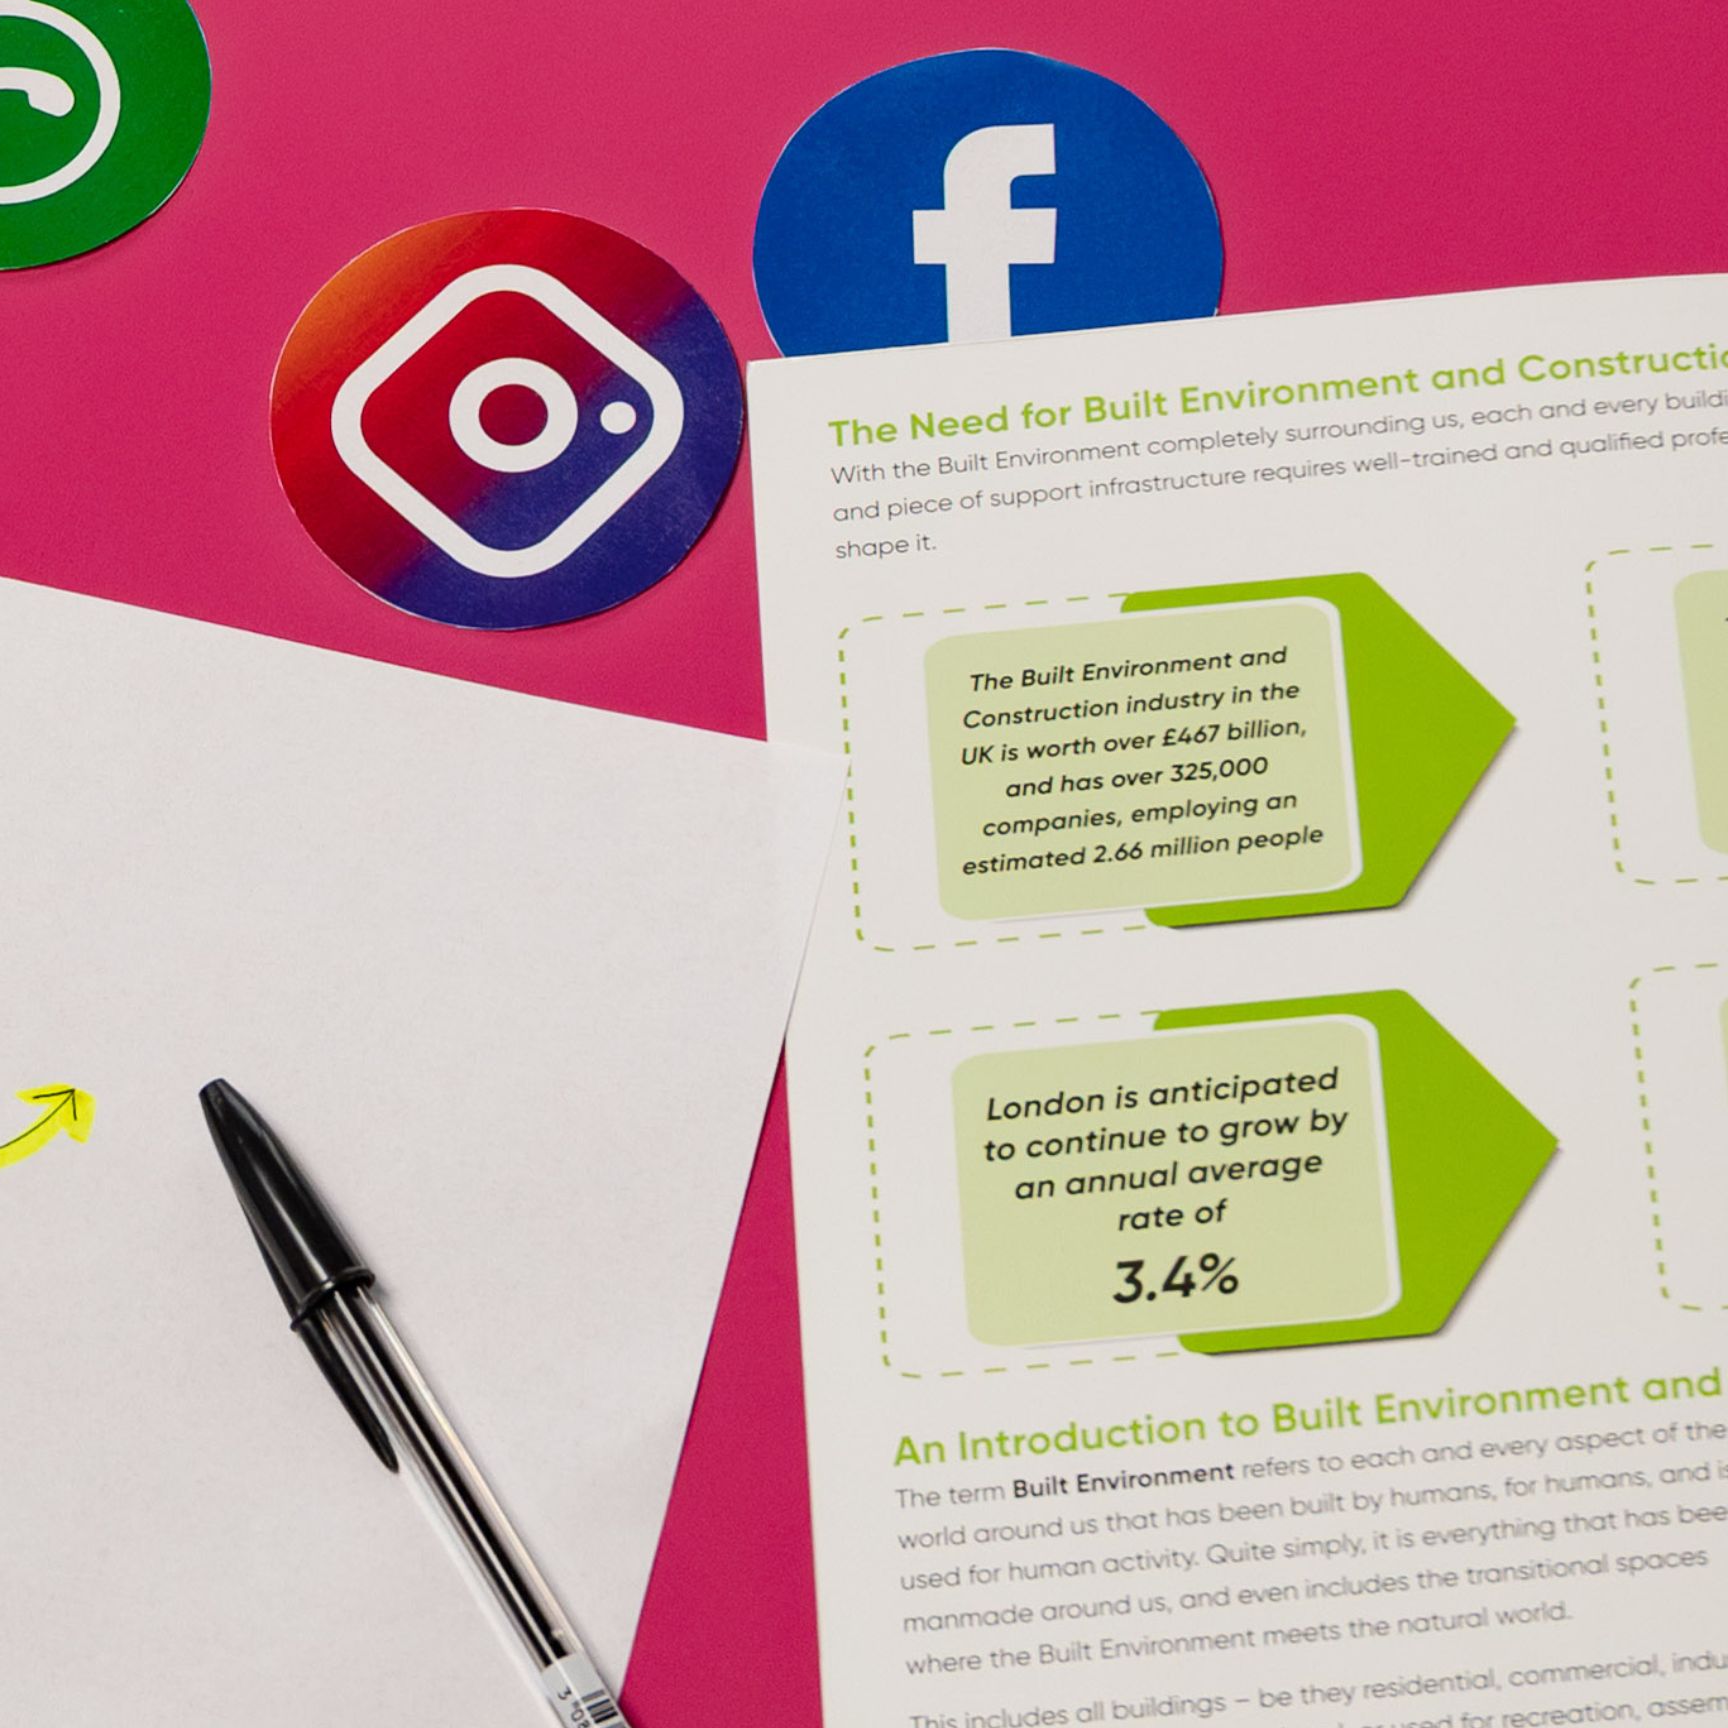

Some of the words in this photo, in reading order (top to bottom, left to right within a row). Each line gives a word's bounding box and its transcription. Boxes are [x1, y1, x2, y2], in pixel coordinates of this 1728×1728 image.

[826, 417, 899, 449] The
[909, 403, 1010, 441] Need
[1019, 400, 1073, 430] for
[1082, 388, 1170, 425] Built
[1178, 367, 1421, 416] Environment
[1429, 356, 1507, 392] and
[828, 462, 887, 486] With
[890, 459, 933, 481] the
[936, 451, 990, 476] Built
[994, 439, 1142, 471] Environment
[1145, 425, 1280, 457] completely
[1283, 413, 1427, 444] surrounding
[1430, 412, 1466, 431] us,
[1469, 402, 1534, 427] each
[1537, 397, 1588, 421] and
[1591, 396, 1660, 418] every
[968, 671, 1015, 693] The
[1020, 663, 1076, 689] Built
[1081, 651, 1234, 683] Environment
[1238, 644, 1289, 669] and
[961, 698, 1120, 730] Construction
[1125, 690, 1226, 715] industry
[1230, 684, 1254, 705] in
[1258, 681, 1301, 703] the
[960, 743, 996, 767] UK
[999, 742, 1020, 763] is
[1025, 735, 1097, 761] worth
[1102, 733, 1157, 754] over
[1160, 722, 1222, 748] £467
[1226, 718, 1307, 742] billion,
[1004, 774, 1055, 799] and
[1059, 773, 1105, 794] has
[1110, 769, 1165, 789] over
[1169, 755, 1270, 784] 325,000
[981, 807, 1124, 838] companies,
[1129, 795, 1260, 826] employing
[1264, 793, 1299, 812] an
[961, 845, 1088, 877] estimated
[1091, 840, 1145, 865] 2.66
[1149, 834, 1231, 860] million
[1235, 824, 1325, 856] people
[985, 1089, 1106, 1122] London
[1114, 1084, 1140, 1111] is
[1147, 1064, 1340, 1108] anticipated
[982, 1139, 1017, 1164] to
[1025, 1126, 1168, 1160] continue
[1176, 1121, 1210, 1145] to
[1218, 1115, 1301, 1148] grow
[1309, 1107, 1350, 1138] by
[1013, 1178, 1056, 1201] an
[1064, 1159, 1179, 1197] annual
[1186, 1153, 1324, 1186] average
[1117, 1205, 1186, 1233] rate
[1193, 1196, 1229, 1226] of
[1111, 1251, 1240, 1305] 3.4%
[893, 1434, 947, 1468] An
[958, 1413, 1208, 1462] Introduction
[1216, 1410, 1261, 1439] to
[1271, 1395, 1363, 1435] Built
[1374, 1376, 1631, 1426] Environment
[1641, 1365, 1724, 1403] and
